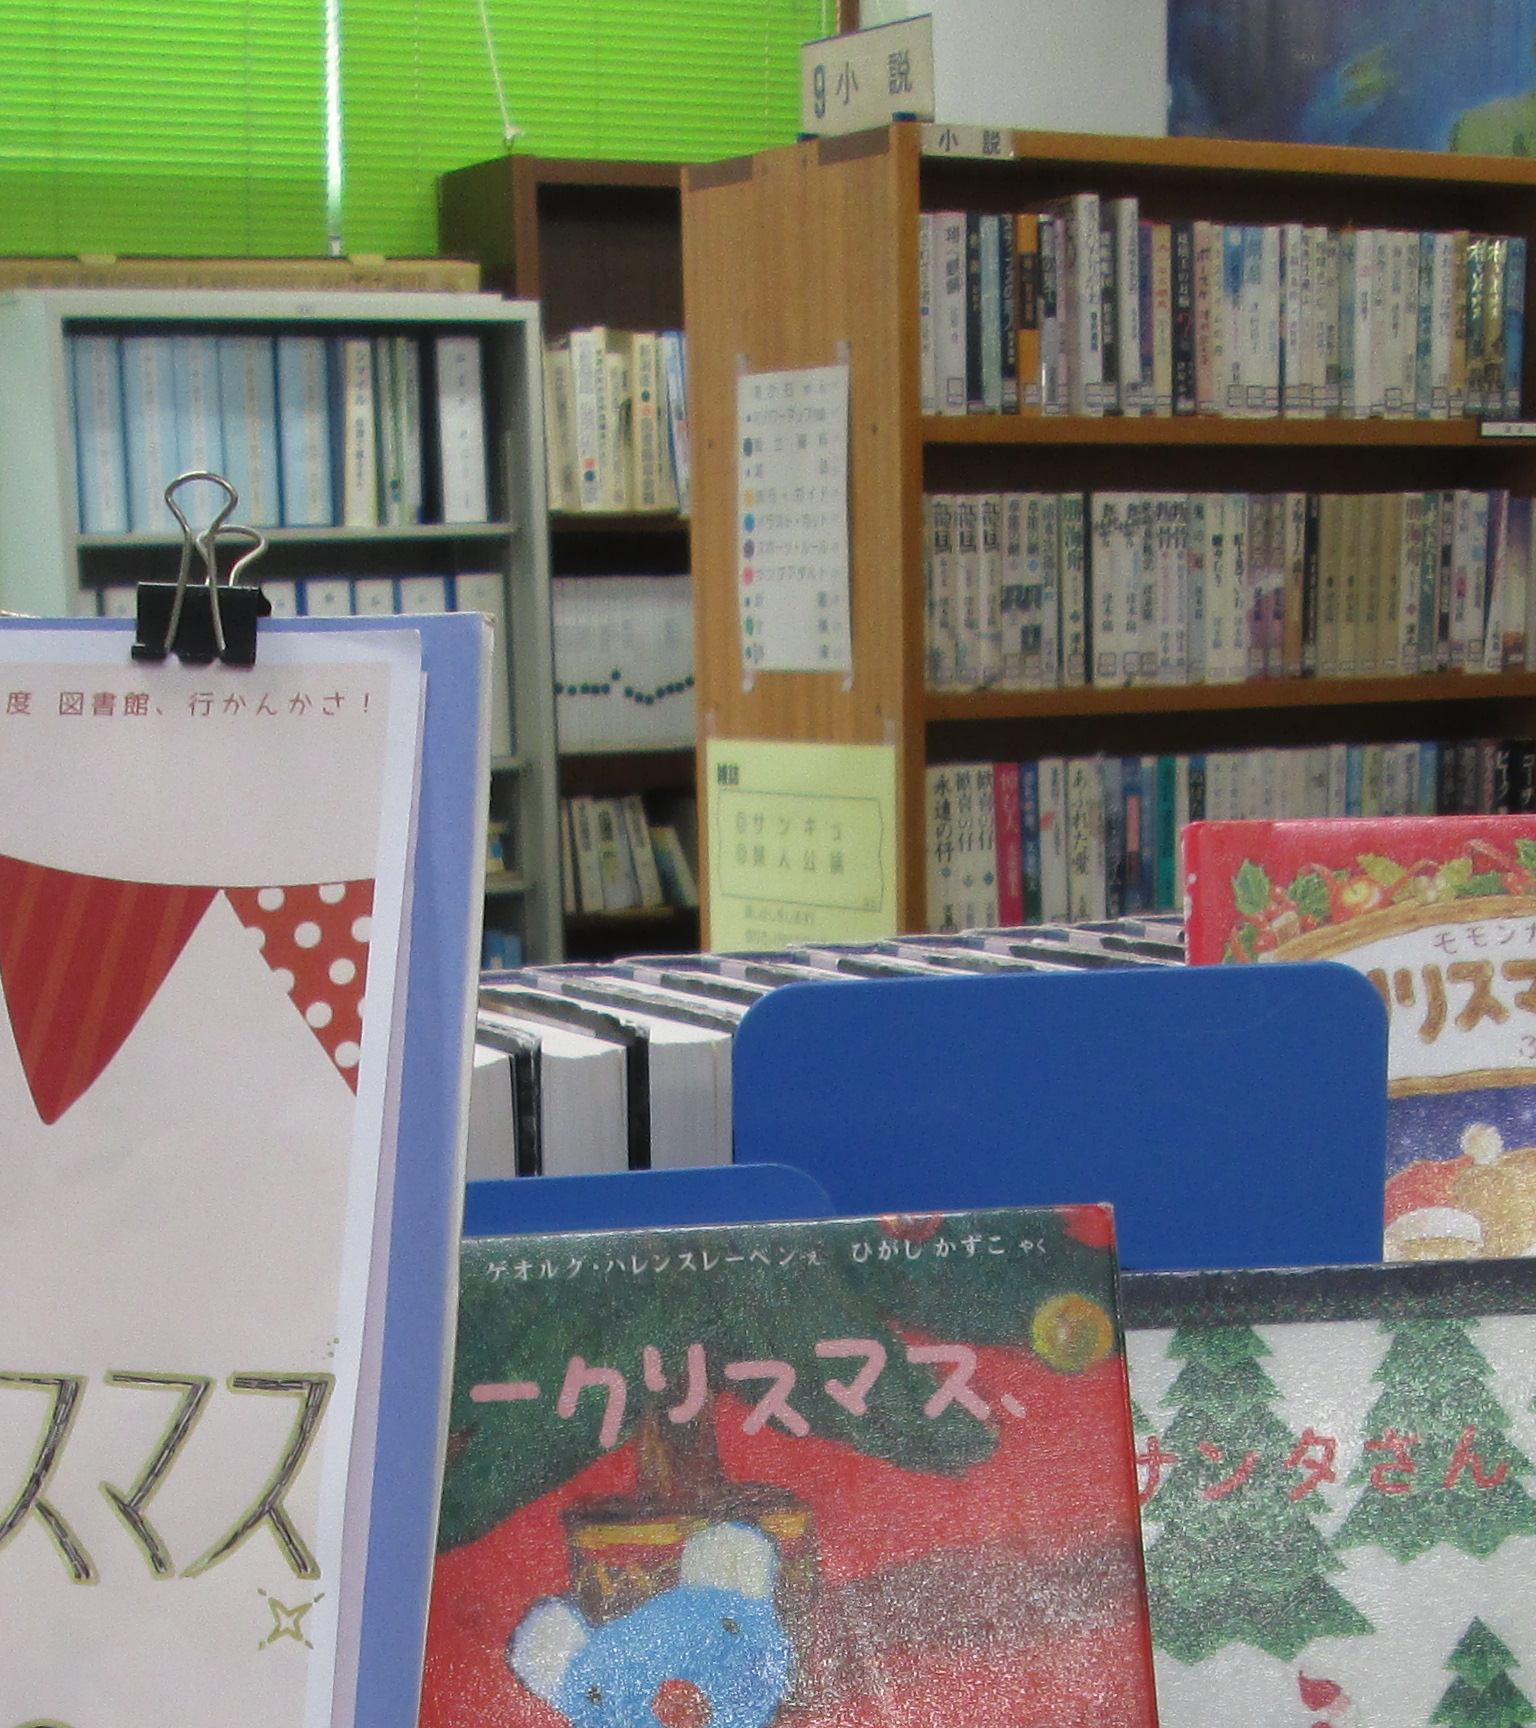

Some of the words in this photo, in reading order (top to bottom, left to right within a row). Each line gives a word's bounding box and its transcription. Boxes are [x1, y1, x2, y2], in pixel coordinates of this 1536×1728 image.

[835, 51, 912, 104] 小説
[58, 690, 372, 718] 図書館、行かんかさ!
[851, 1236, 923, 1264] ひがし
[935, 1233, 1005, 1261] かずこ
[1136, 1424, 1507, 1503] サンタさん
